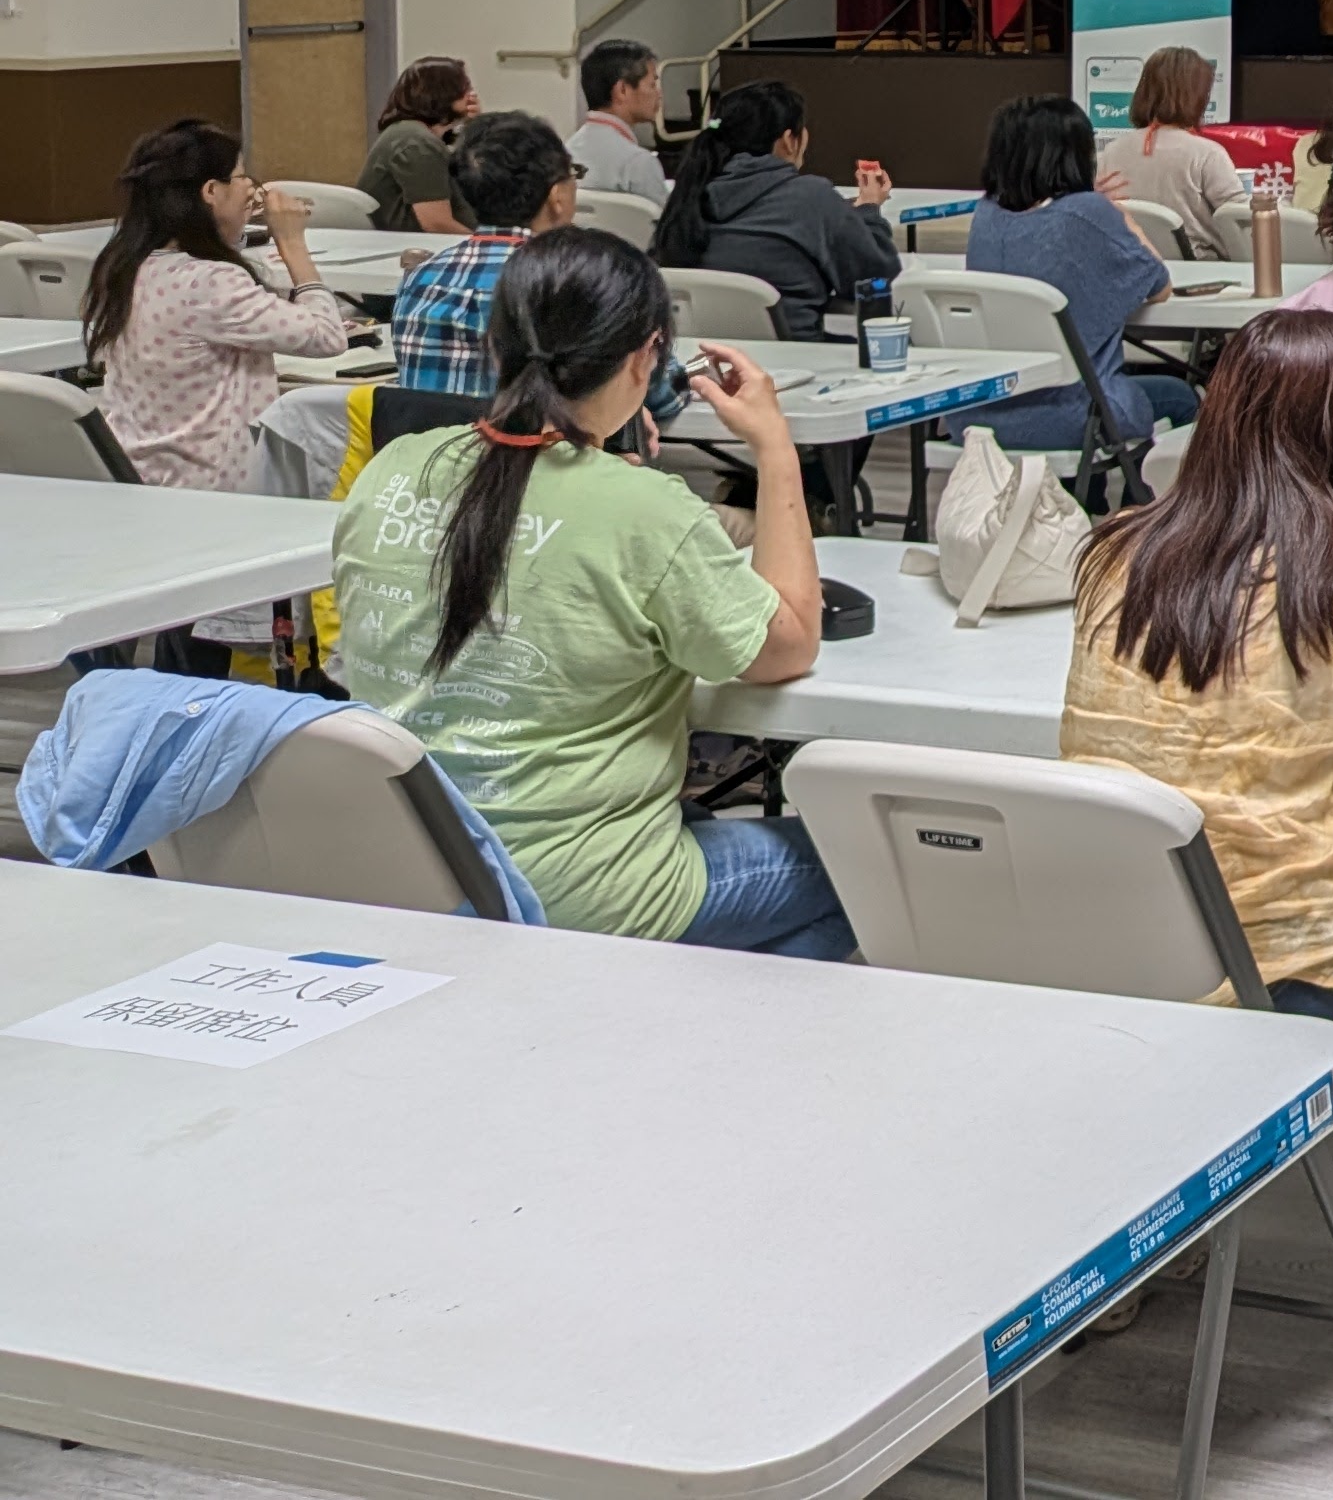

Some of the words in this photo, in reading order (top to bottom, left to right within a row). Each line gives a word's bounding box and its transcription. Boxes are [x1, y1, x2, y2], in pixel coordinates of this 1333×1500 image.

[925, 832, 974, 847] LIFETIME
[170, 963, 384, 1007] 工作人員
[83, 996, 298, 1042] 保留席位
[1208, 1156, 1227, 1177] MESA
[1209, 1150, 1251, 1189] COMERCIAL
[1210, 1186, 1220, 1201] DE
[1221, 1176, 1233, 1192] 1.8
[1234, 1171, 1241, 1182] m
[1128, 1214, 1150, 1237] TABLE
[1151, 1190, 1180, 1220] PLIANTE
[1129, 1200, 1185, 1249] COMMERCIALE
[1130, 1247, 1141, 1262] DE
[1143, 1236, 1155, 1252] 1.8
[1156, 1230, 1165, 1242] m
[1041, 1273, 1071, 1303] 6-FOOT
[1042, 1266, 1100, 1316] COMMERCIAL
[1044, 1294, 1081, 1329] FOLDING
[1082, 1274, 1106, 1299] TABLE
